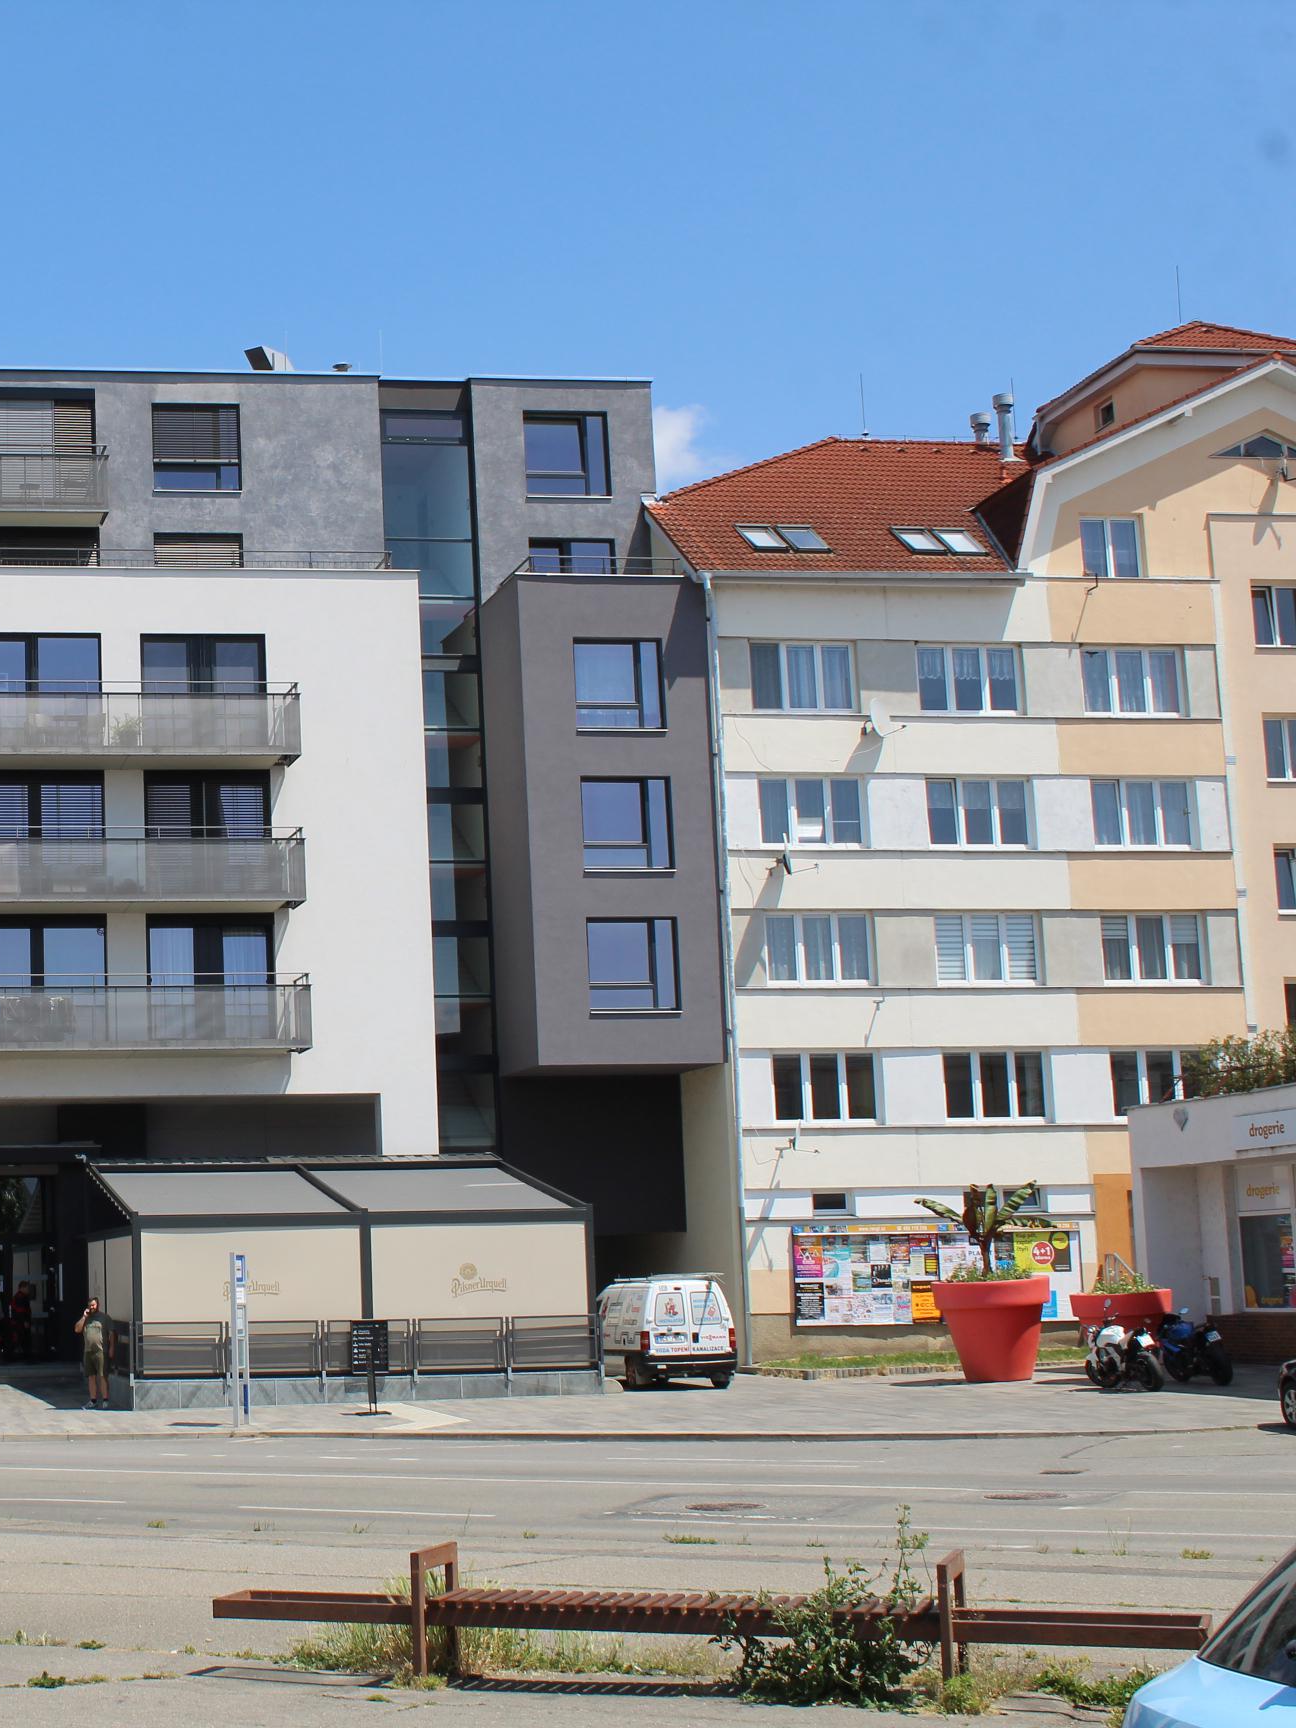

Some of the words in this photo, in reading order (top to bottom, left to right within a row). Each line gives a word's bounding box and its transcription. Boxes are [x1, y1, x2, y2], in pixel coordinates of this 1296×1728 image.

[1249, 1120, 1285, 1139] drogerie
[1247, 1183, 1280, 1199] drogerie
[1033, 1246, 1051, 1256] 4+1
